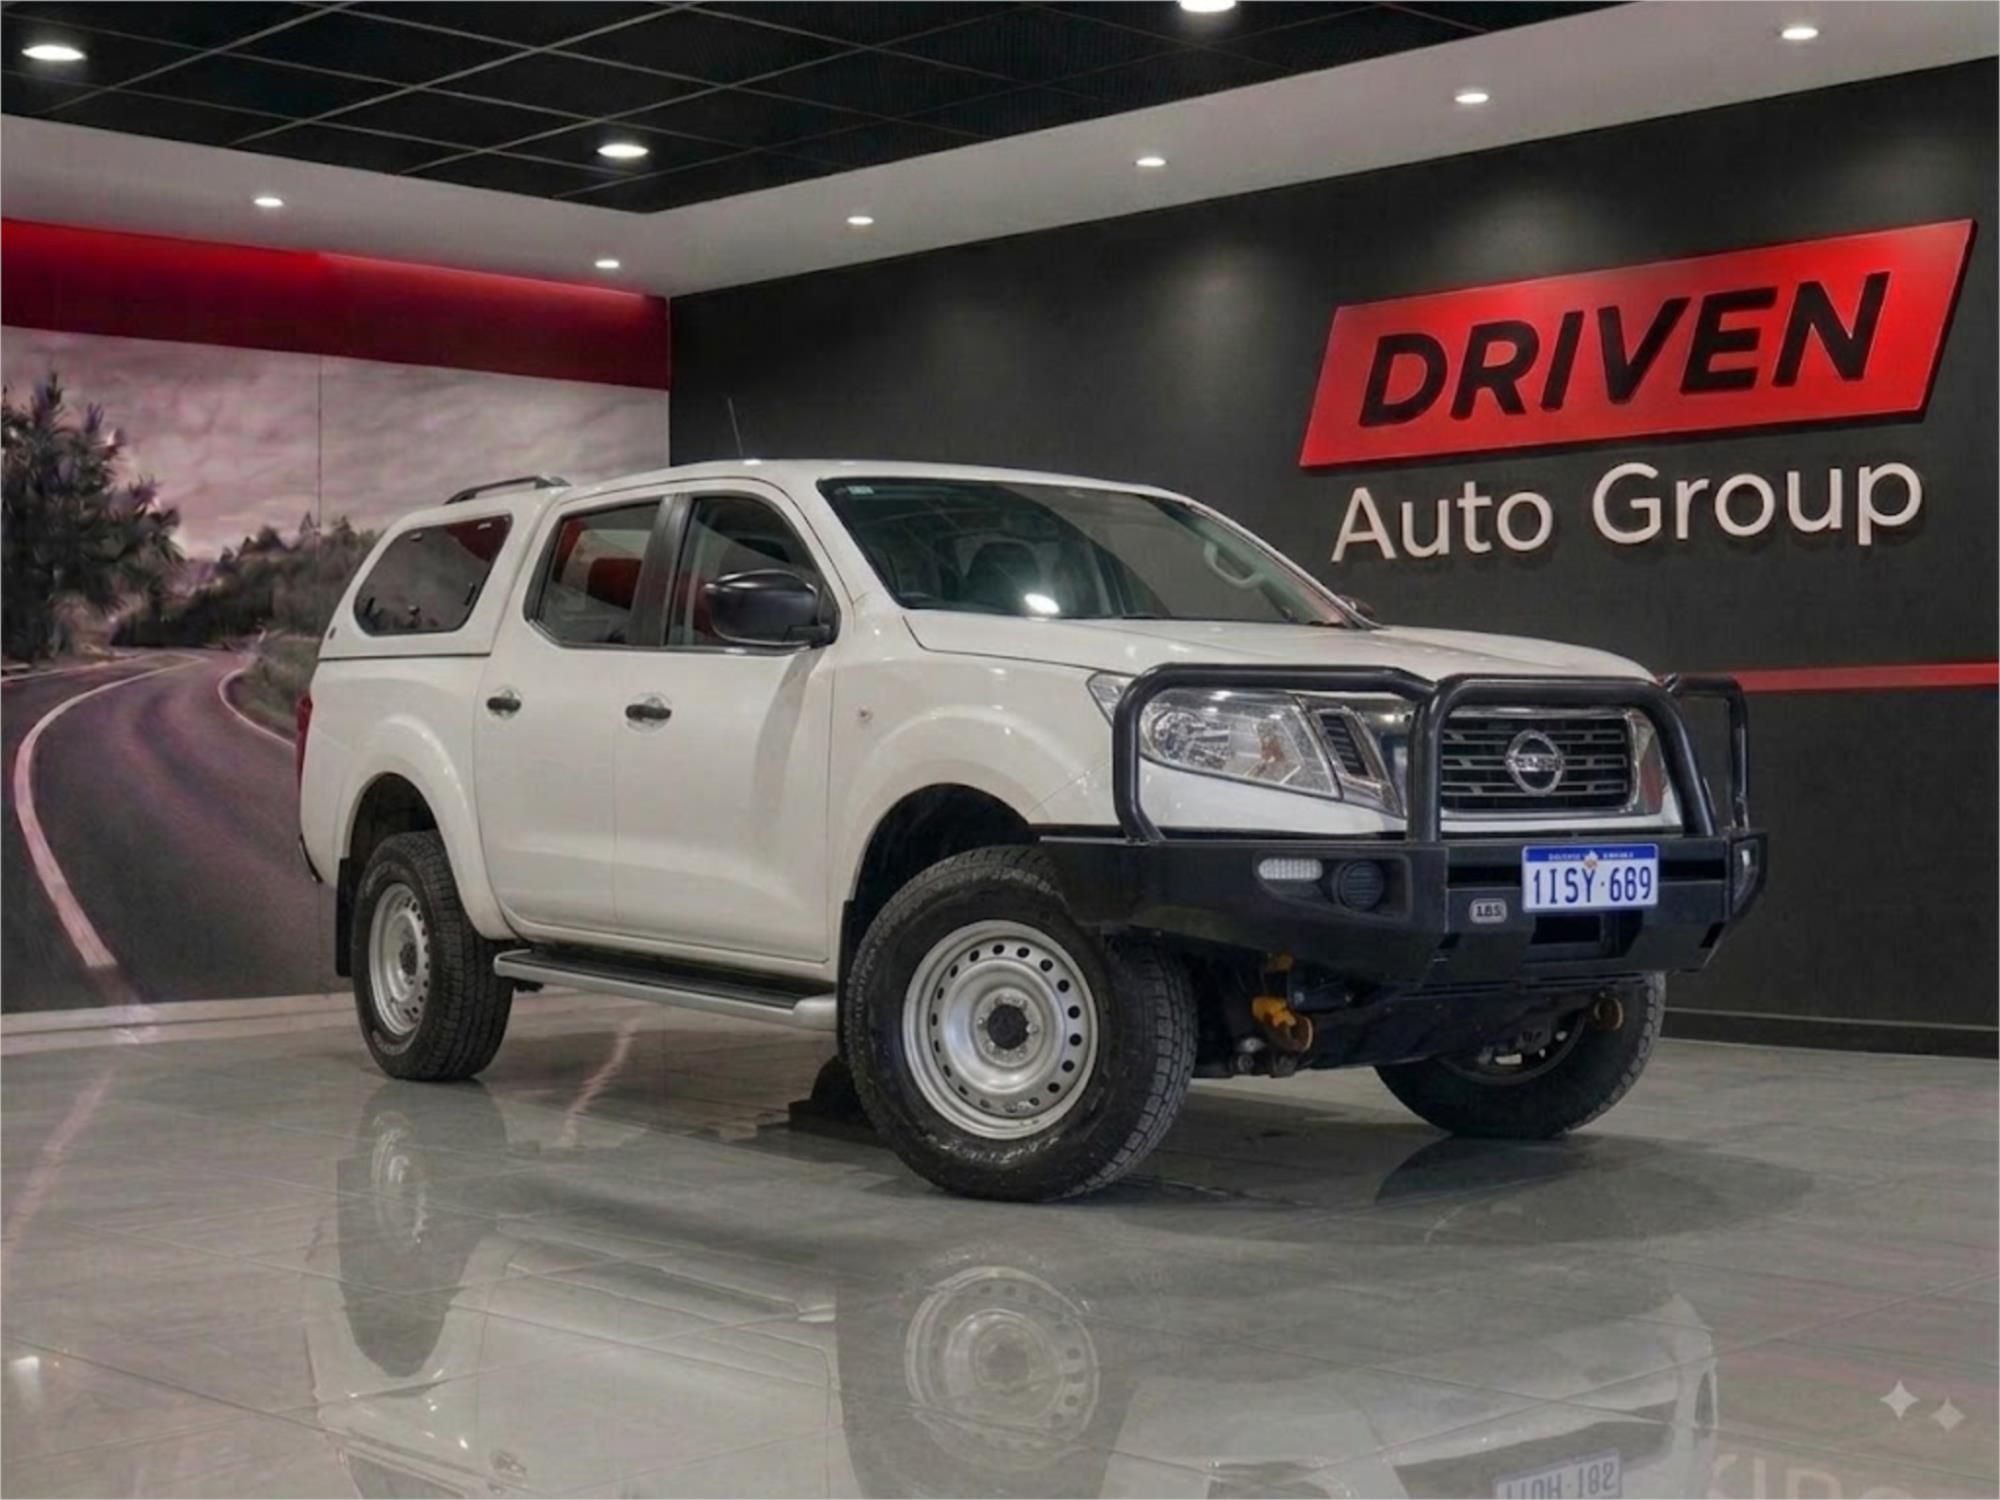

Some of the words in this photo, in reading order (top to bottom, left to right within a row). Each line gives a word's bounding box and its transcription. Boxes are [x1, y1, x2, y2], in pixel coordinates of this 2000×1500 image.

[1358, 270, 1891, 428] DRIVEN
[1331, 480, 1554, 563] Auto
[1592, 460, 1923, 546] Group
